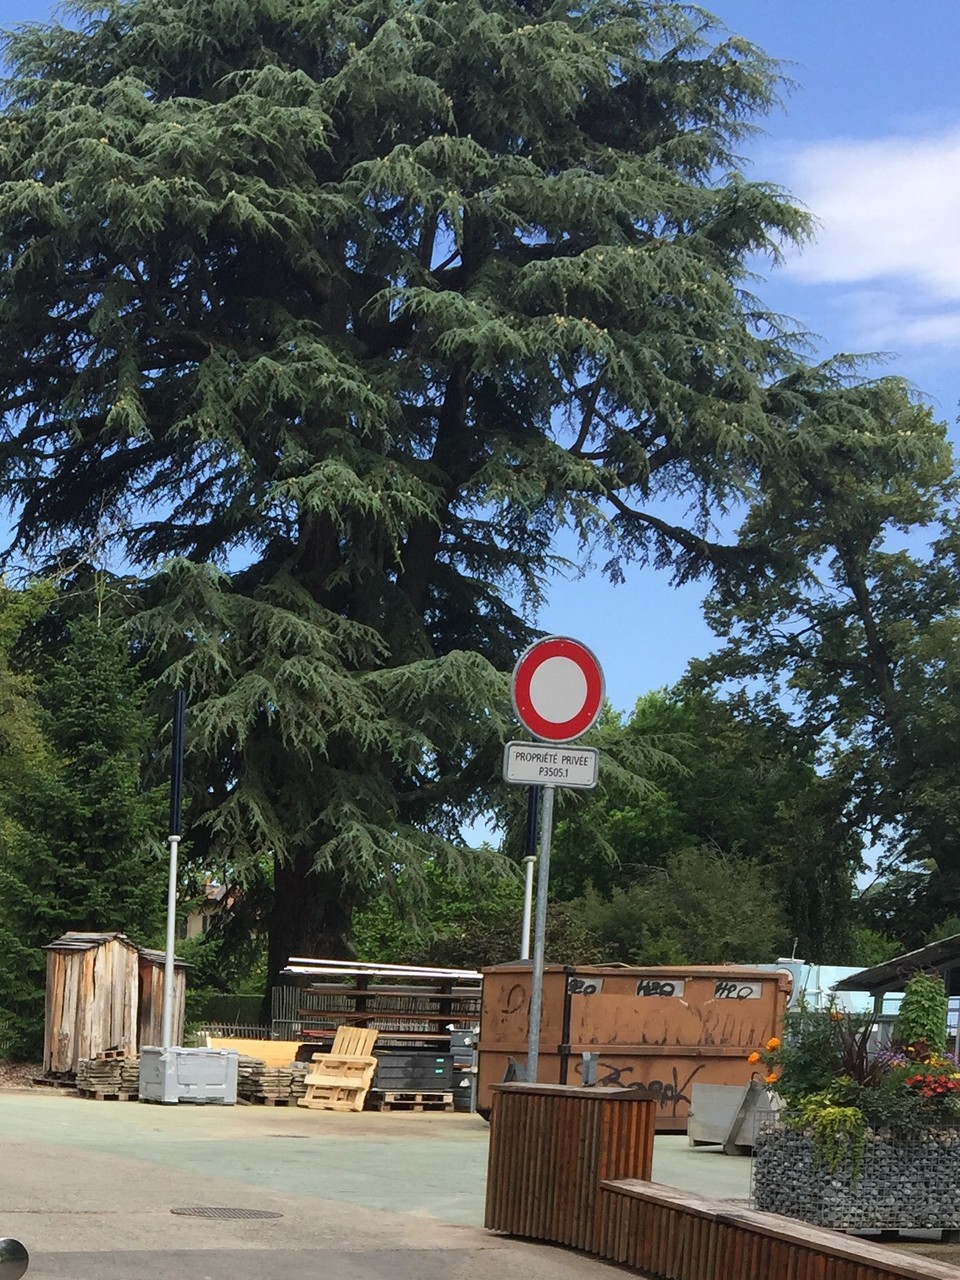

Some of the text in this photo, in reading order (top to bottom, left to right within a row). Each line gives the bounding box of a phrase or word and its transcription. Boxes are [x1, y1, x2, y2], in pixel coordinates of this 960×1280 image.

[515, 751, 589, 766] PROPRIÉTÉ PRIVÉE
[538, 766, 569, 778] P3505.1
